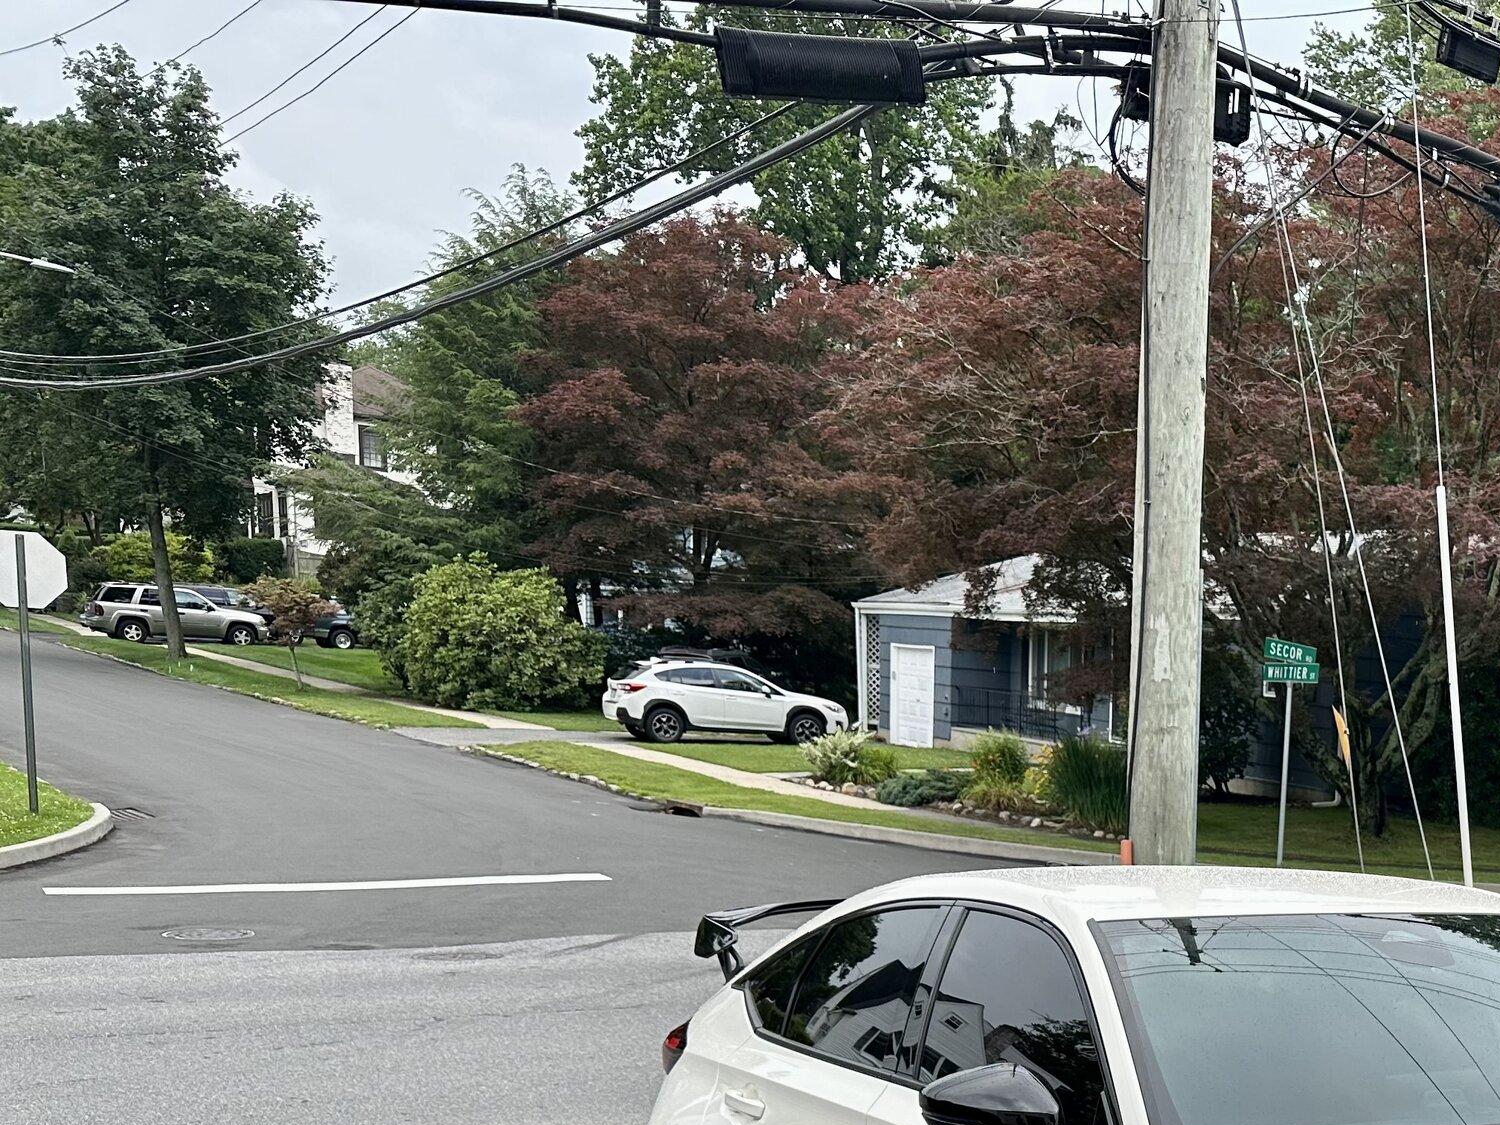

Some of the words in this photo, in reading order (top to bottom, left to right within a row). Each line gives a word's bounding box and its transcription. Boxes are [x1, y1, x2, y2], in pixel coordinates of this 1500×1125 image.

[1269, 642, 1303, 661] SECOR
[1267, 666, 1308, 679] WHITTIER
[1309, 672, 1316, 680] ST
